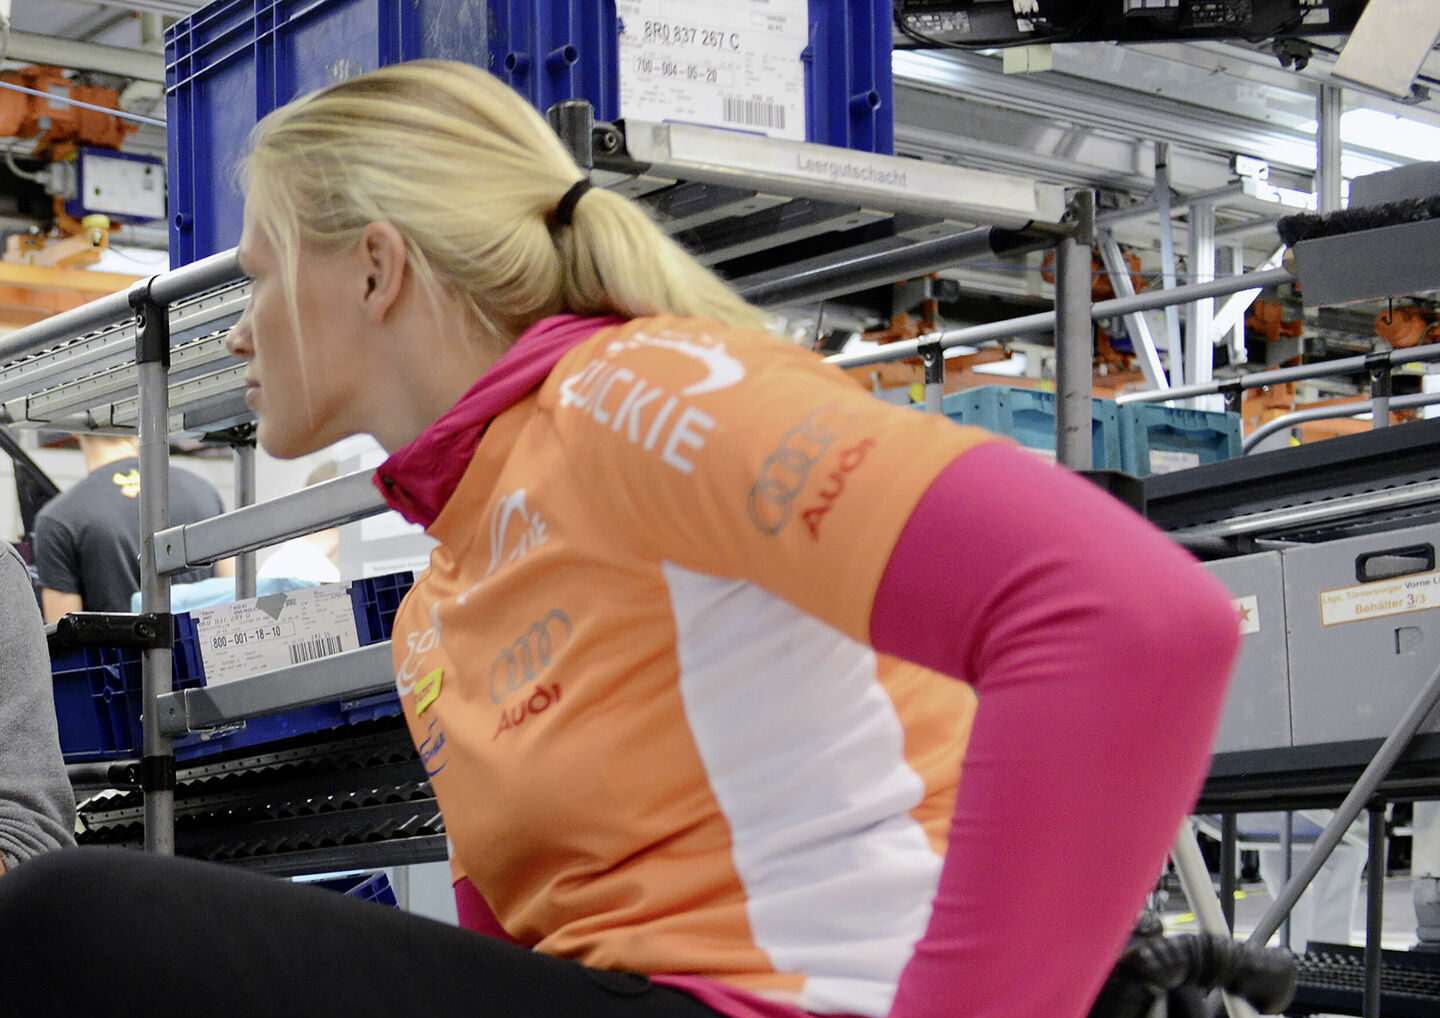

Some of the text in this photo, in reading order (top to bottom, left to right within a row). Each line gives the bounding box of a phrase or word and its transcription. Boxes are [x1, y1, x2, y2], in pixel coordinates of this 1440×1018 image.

[674, 25, 697, 44] 837
[701, 29, 725, 49] 267
[729, 32, 740, 50] C
[796, 151, 908, 188] Leergutschacht
[1405, 579, 1431, 590] Vorne
[212, 624, 282, 650] 800-001-18-10
